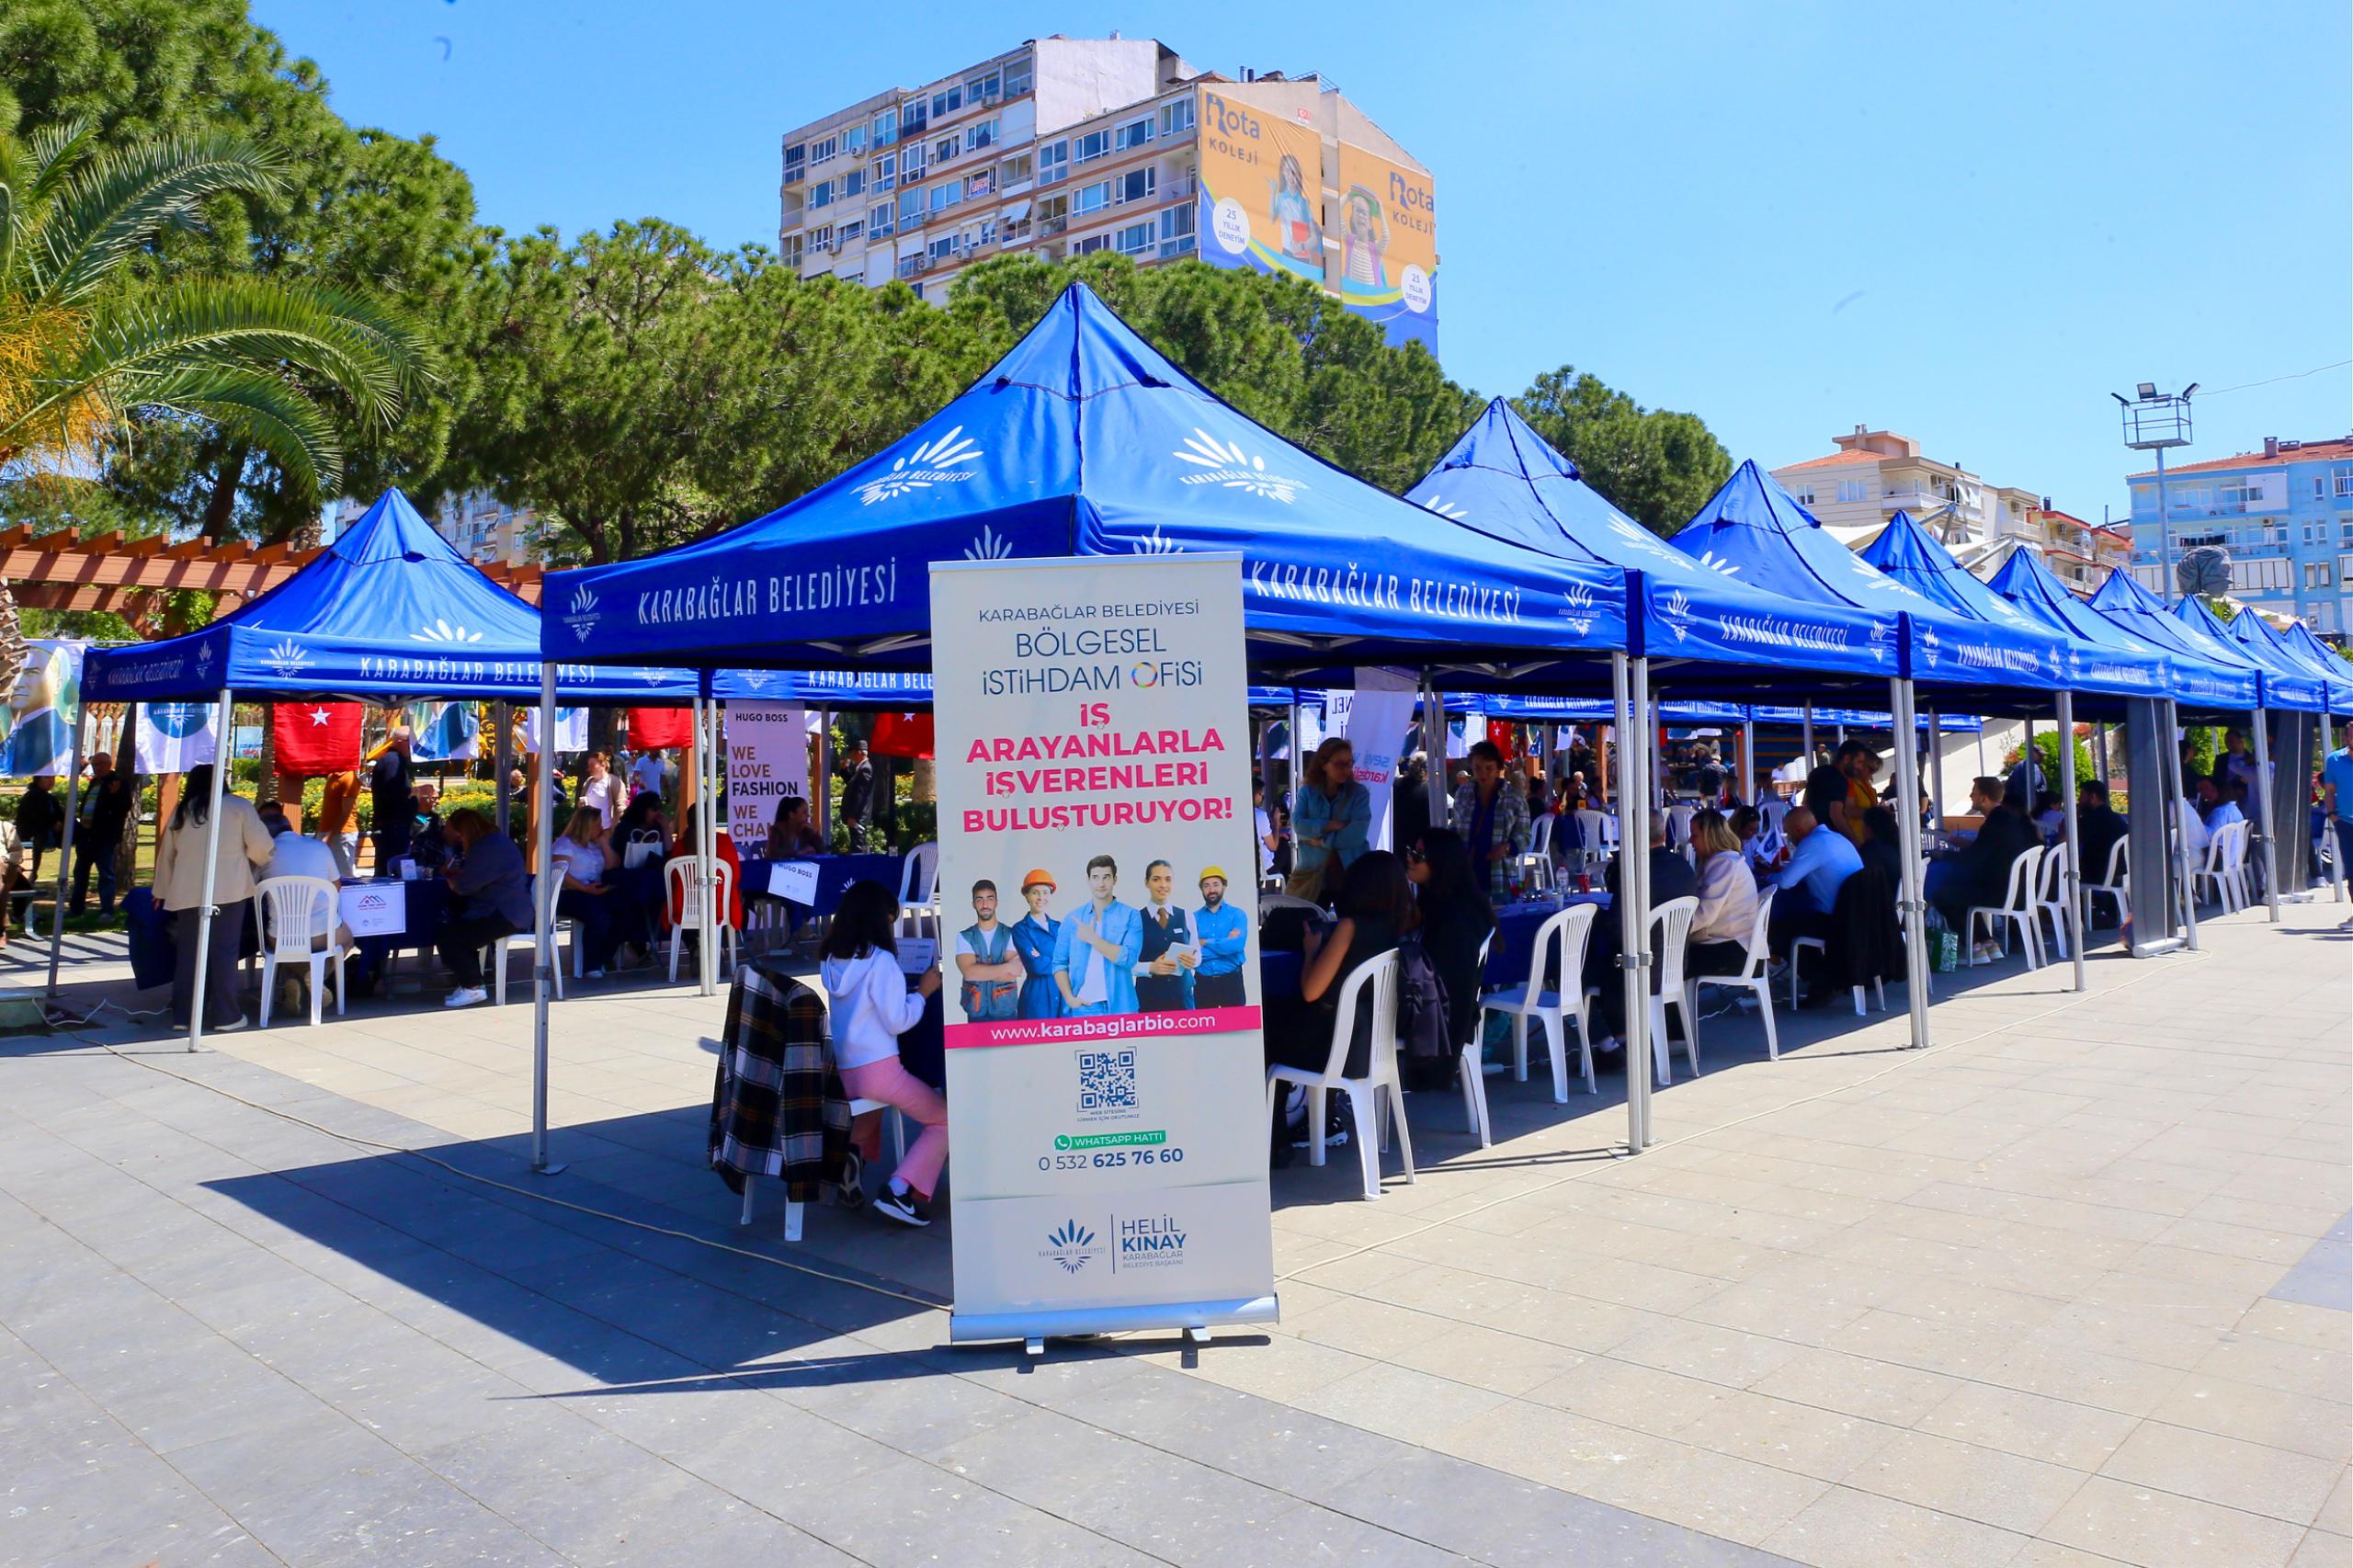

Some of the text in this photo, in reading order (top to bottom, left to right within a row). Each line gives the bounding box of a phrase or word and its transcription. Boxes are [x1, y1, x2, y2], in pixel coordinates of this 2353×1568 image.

[1206, 92, 1260, 140] Rota
[1209, 137, 1258, 165] KOLEJİ
[1390, 171, 1434, 212] Rota
[1226, 208, 1236, 220] 25
[1392, 211, 1433, 235] KOLEJİ
[1218, 229, 1245, 245] DENEYİM
[1222, 220, 1241, 233] YILLIK
[639, 556, 896, 625] KARABAĞLAR BELEDİYESİ
[1251, 561, 1521, 624] KARABAĞLAR BELEDİYESİ
[979, 598, 1199, 622] KARABAĞLAR BELEDİYESİ
[1017, 626, 1166, 657] BÖLGESEL
[359, 656, 483, 682] KARABAĞLAR
[983, 661, 1202, 695] İSTİHDAM OFİSİ
[735, 713, 788, 722] HUGO BOSS
[732, 746, 756, 760] WE
[967, 728, 1224, 763] ARAYANLARLA
[732, 764, 771, 778] LOVE
[733, 781, 798, 796] FASHION
[733, 805, 757, 819] WE
[797, 869, 813, 878] BOSS
[991, 1015, 1216, 1040] www.karabaglarbio.com
[1075, 1132, 1163, 1146] WHATSAPP HATTI
[1039, 1148, 1184, 1171] 0 532 625 76 60
[1122, 1214, 1181, 1235] HELİL
[1122, 1233, 1187, 1252] KINAY
